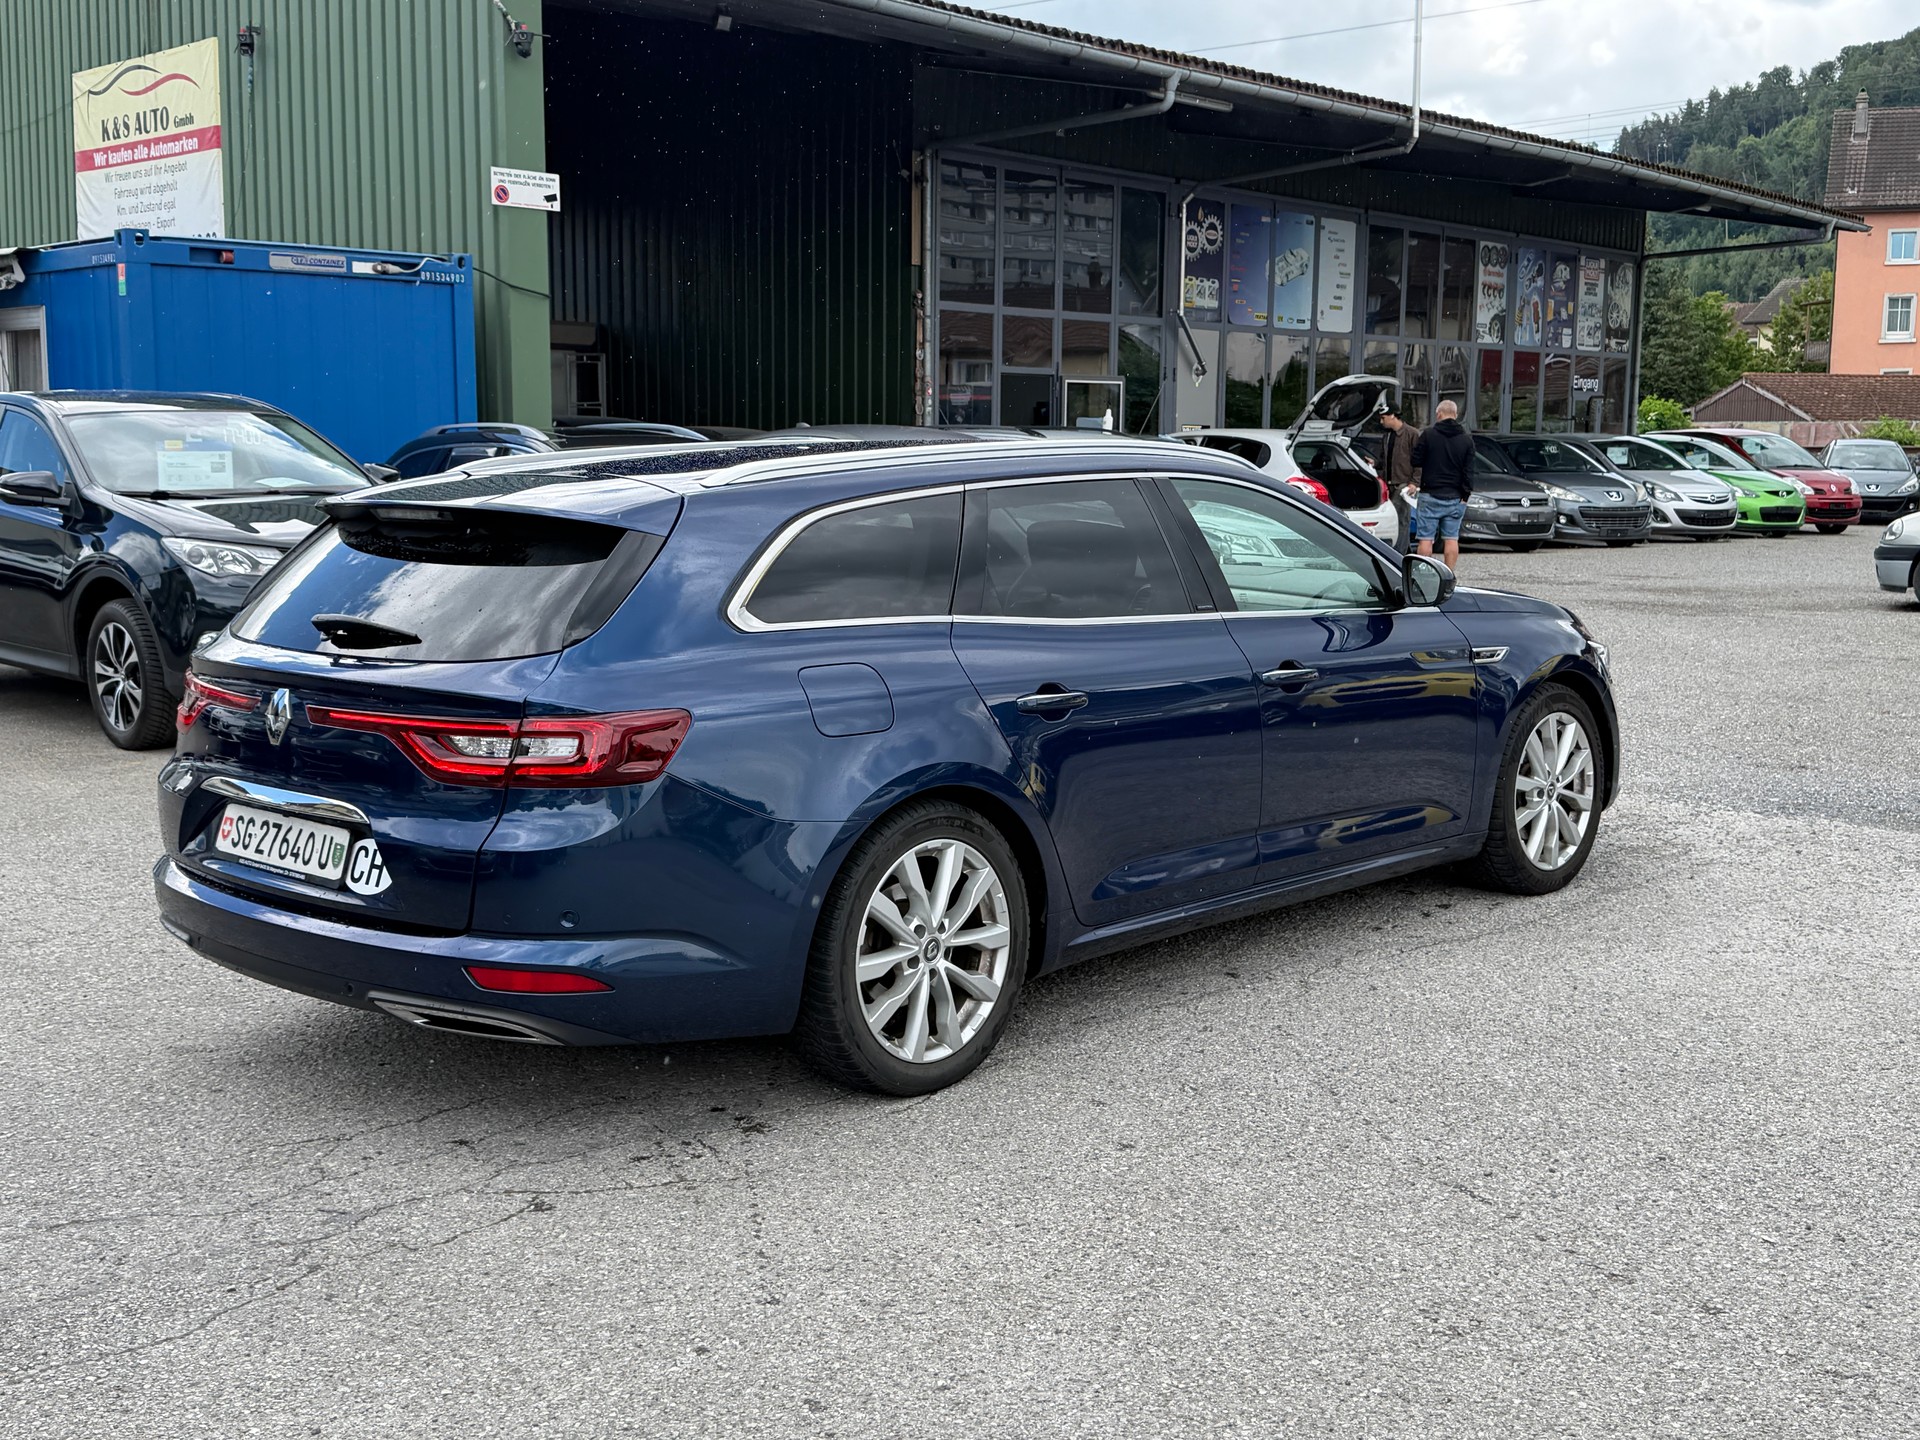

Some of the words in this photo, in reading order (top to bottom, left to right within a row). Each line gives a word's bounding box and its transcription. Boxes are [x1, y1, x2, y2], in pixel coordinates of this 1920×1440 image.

[101, 114, 130, 142] K&S
[134, 106, 170, 135] AUTO
[173, 113, 195, 129] Gmbh
[93, 152, 107, 167] Wir
[108, 148, 132, 165] kaufen
[133, 144, 148, 161] alle
[149, 136, 198, 158] Automarken
[104, 171, 114, 183] Wir
[114, 169, 132, 182] freuen
[132, 169, 143, 179] uns
[143, 164, 153, 178] auf
[154, 164, 162, 176] Ihr
[163, 160, 188, 176] Angebot
[114, 186, 138, 199] Fahrzeug
[139, 182, 152, 196] wird
[153, 180, 178, 196] abgeholt
[128, 202, 138, 214] und
[139, 199, 162, 213] Zustand
[163, 196, 176, 212] egal
[156, 214, 176, 230] Export
[309, 257, 345, 266] CONTAINEX
[420, 271, 465, 284] 091534903
[1573, 375, 1599, 393] Eingang
[231, 815, 256, 851] SG
[254, 819, 316, 867] 27640
[318, 834, 334, 870] U
[350, 845, 385, 888] CH
